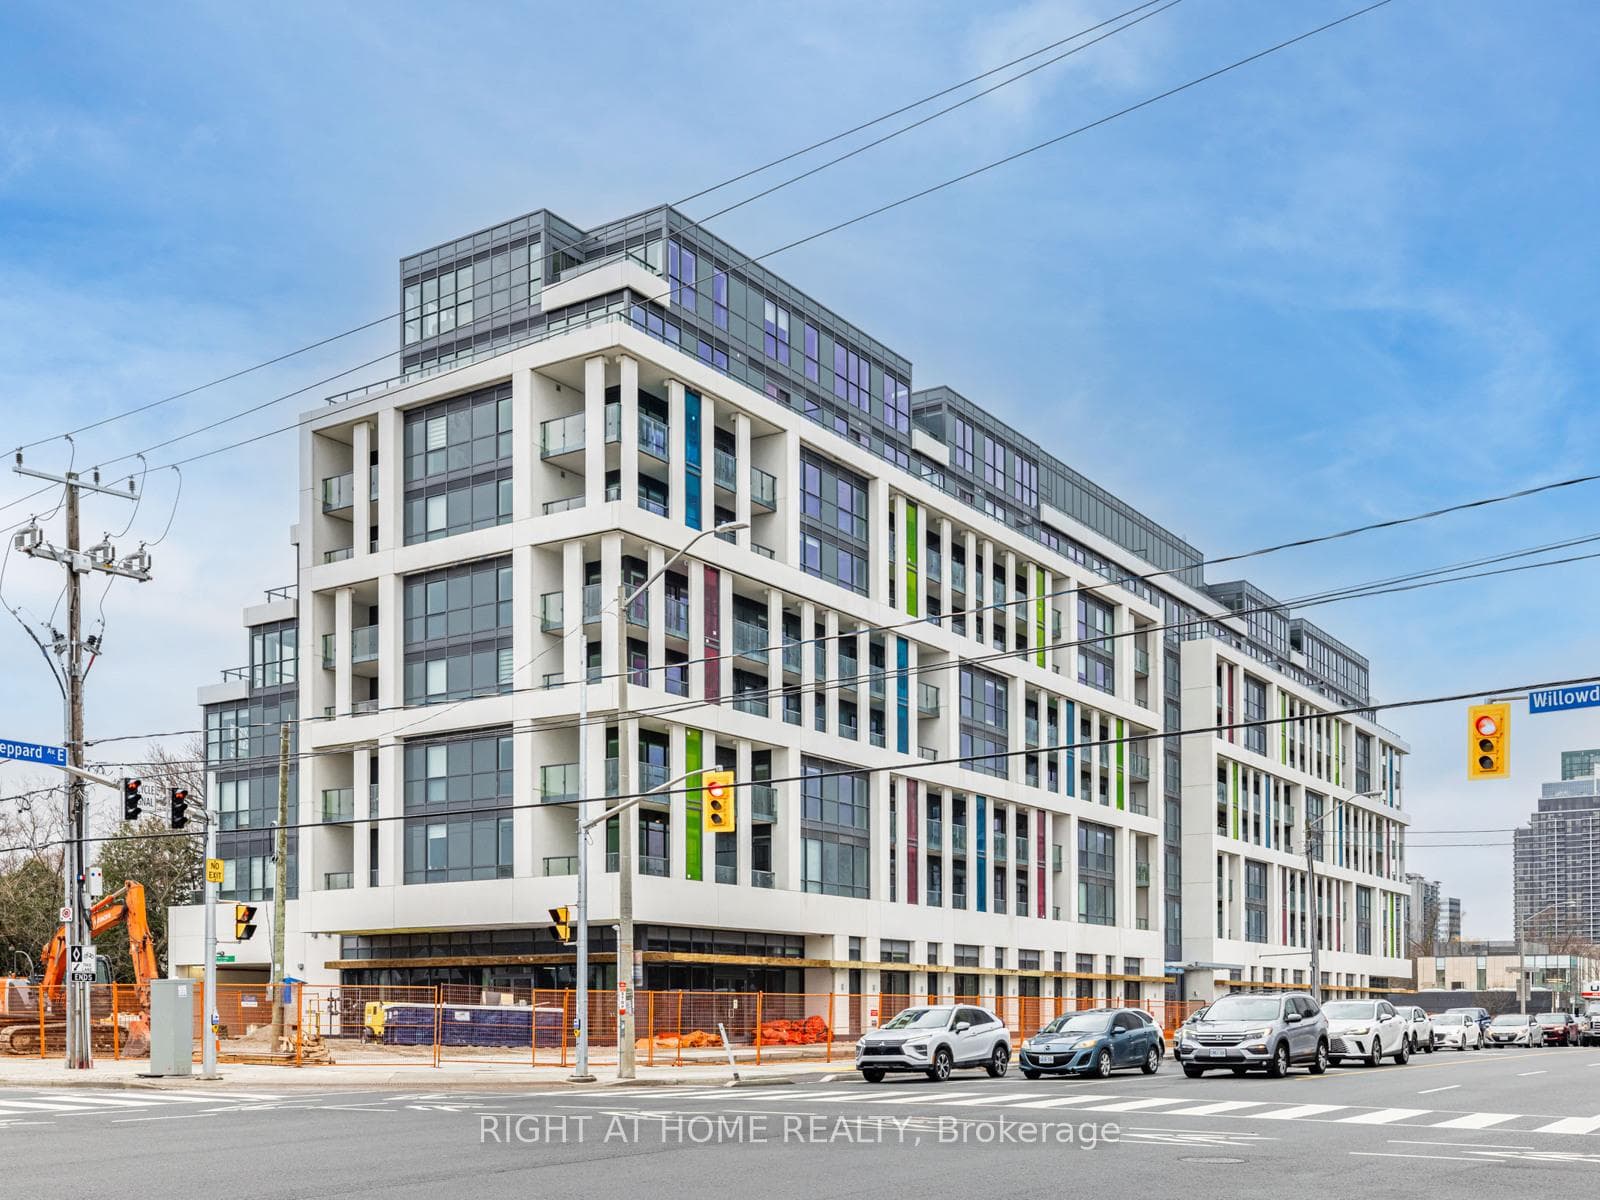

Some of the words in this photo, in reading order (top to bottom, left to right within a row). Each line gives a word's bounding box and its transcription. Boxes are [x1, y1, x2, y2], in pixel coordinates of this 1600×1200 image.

[1533, 685, 1600, 708] Willowd
[0, 742, 42, 759] eppard
[57, 749, 65, 762] E
[210, 862, 220, 870] NO
[208, 871, 222, 880] EXIT
[74, 973, 92, 981] ENDS
